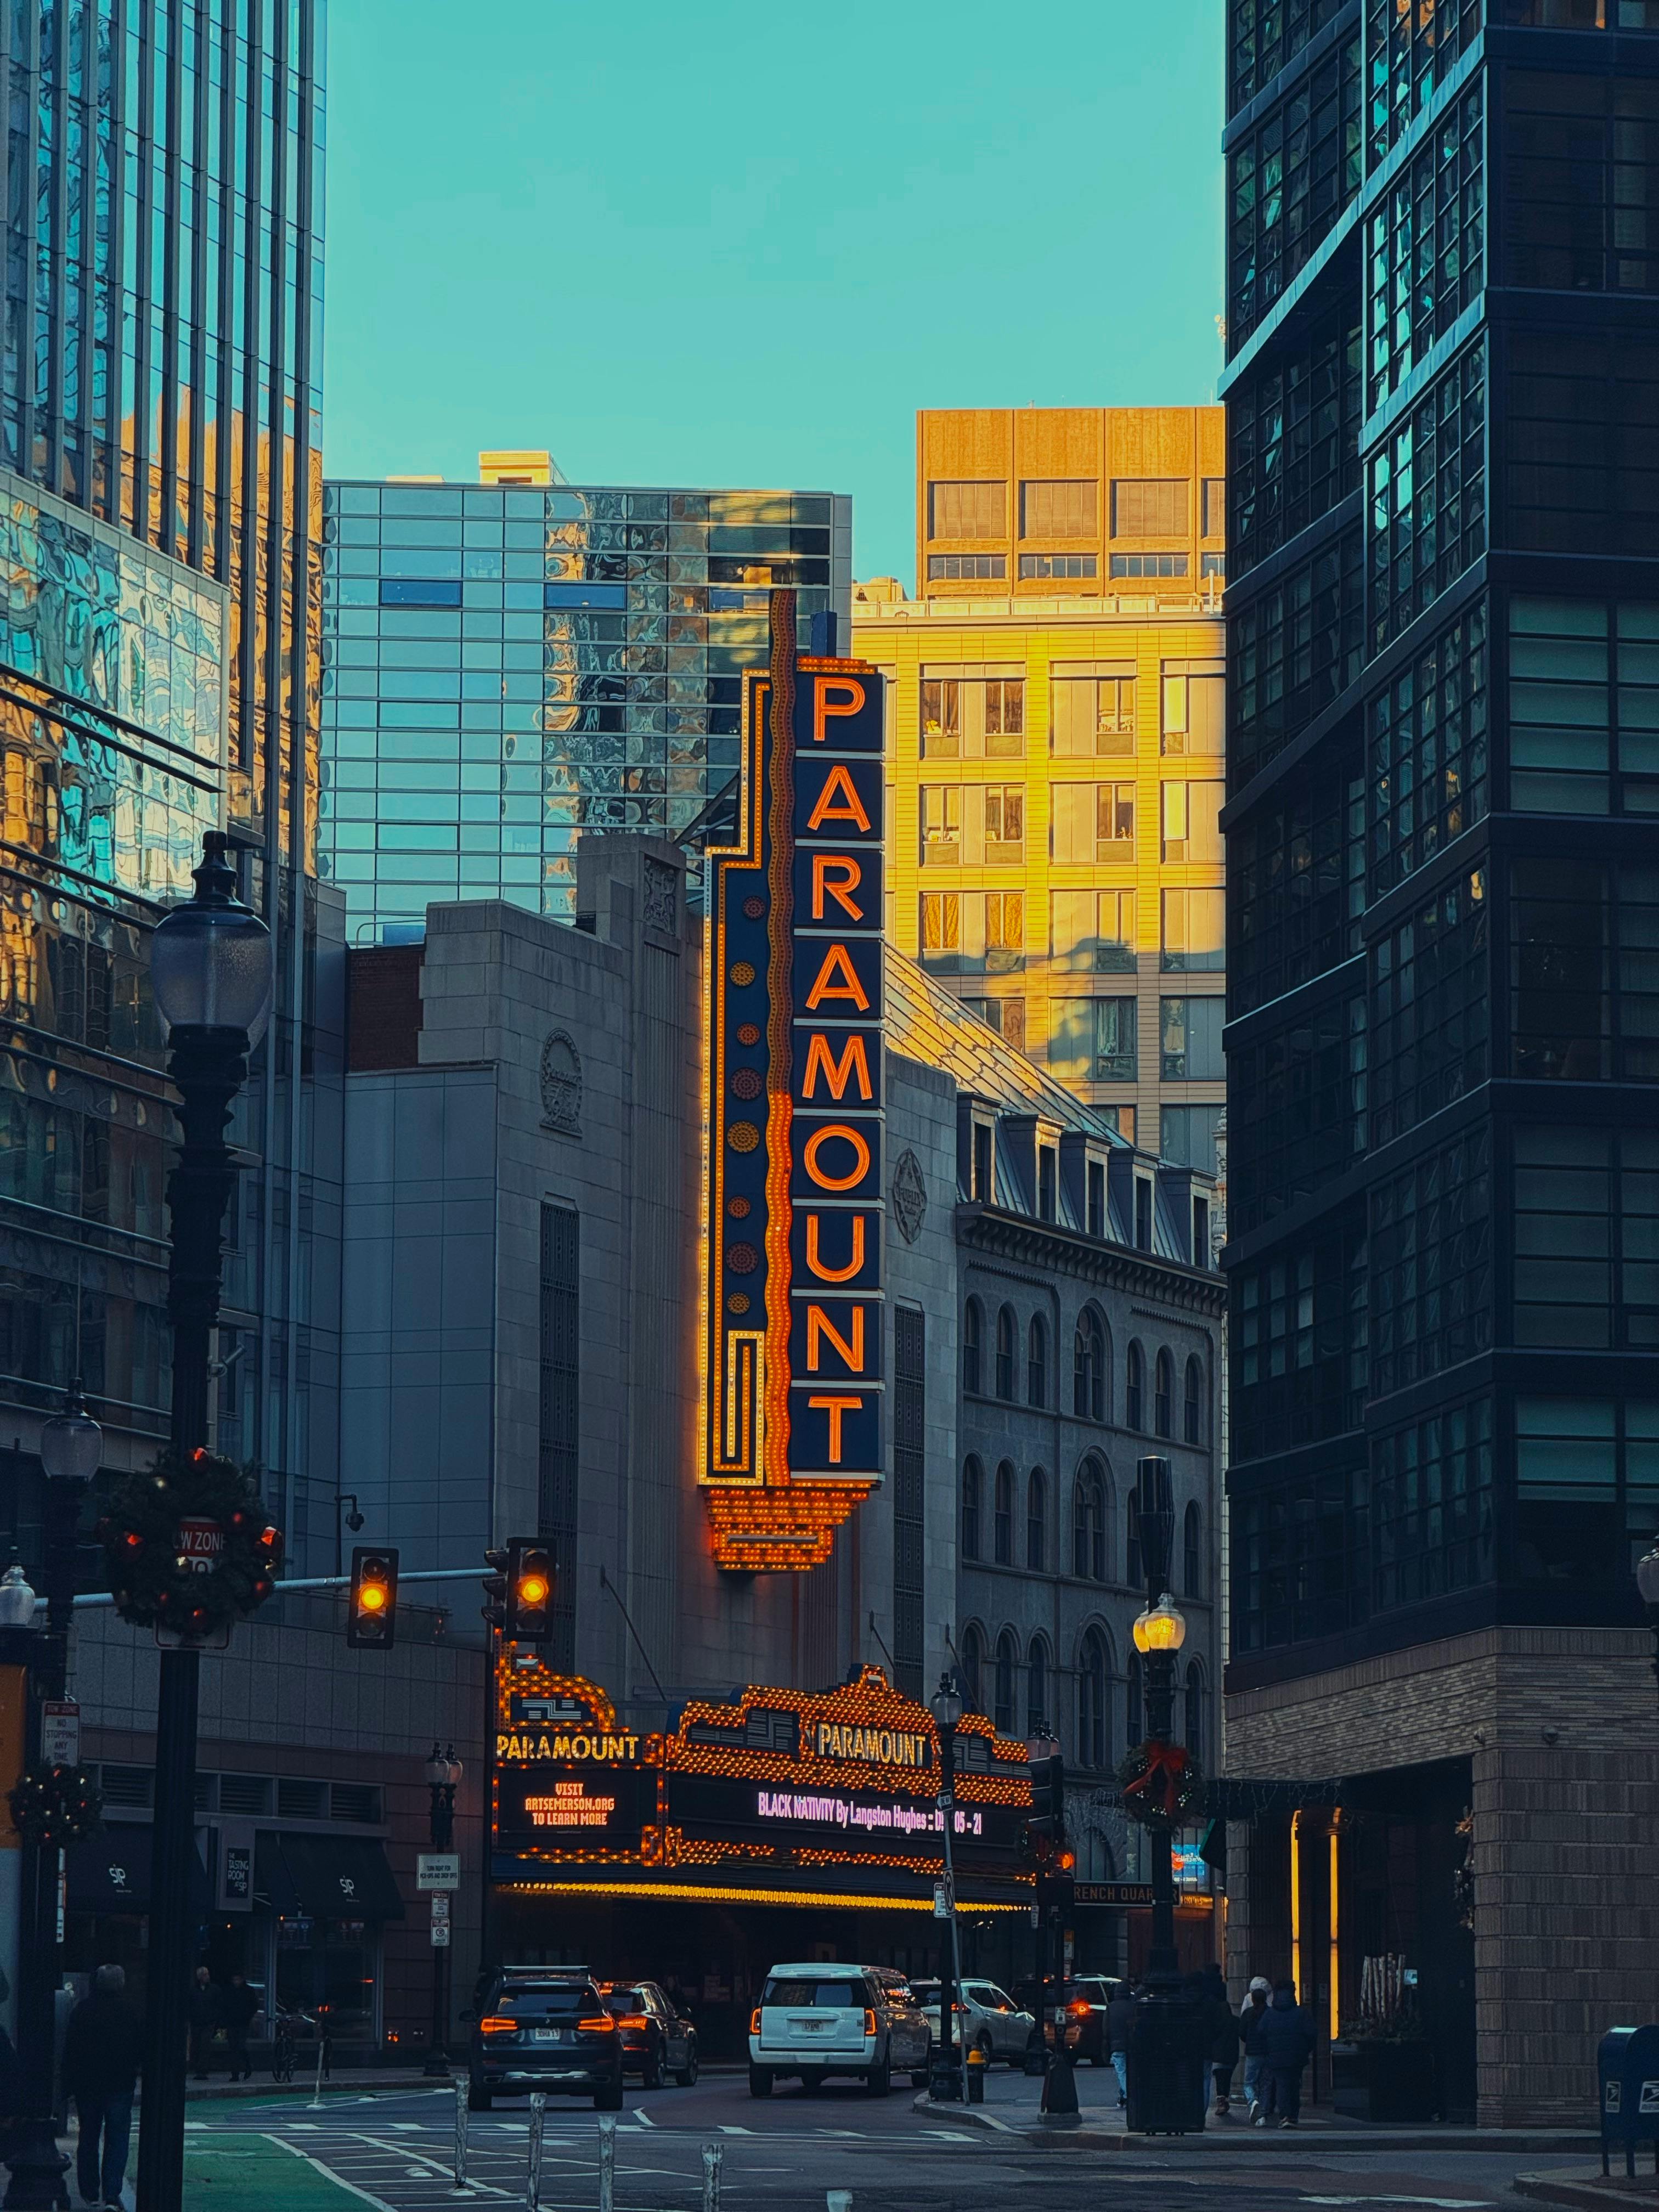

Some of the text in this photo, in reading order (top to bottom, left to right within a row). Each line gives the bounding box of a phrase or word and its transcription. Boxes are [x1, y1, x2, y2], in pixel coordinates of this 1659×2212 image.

[802, 675, 872, 1464] PARAMOUNT
[57, 1719, 66, 1727] NO
[46, 1729, 77, 1739] STOPPING
[54, 1741, 67, 1750] ANY
[496, 1735, 639, 1760] PARAMOUNT
[818, 1723, 926, 1767] PARAMOUNT
[555, 1783, 584, 1796] VISIT
[525, 1797, 615, 1811] ARTSEMERSON.ORG
[532, 1813, 607, 1826] TO LEARN MORE
[758, 1792, 792, 1818] BLACK
[794, 1795, 835, 1822] NATIVITY
[836, 1799, 849, 1829] By
[850, 1801, 891, 1831] Langston
[893, 1805, 927, 1835] Hughes
[954, 1810, 965, 1833] 05
[973, 1813, 981, 1835] 21
[228, 1860, 249, 1870] TASTING
[227, 1870, 245, 1881] ROOM
[1073, 1886, 1115, 1901] RENCH
